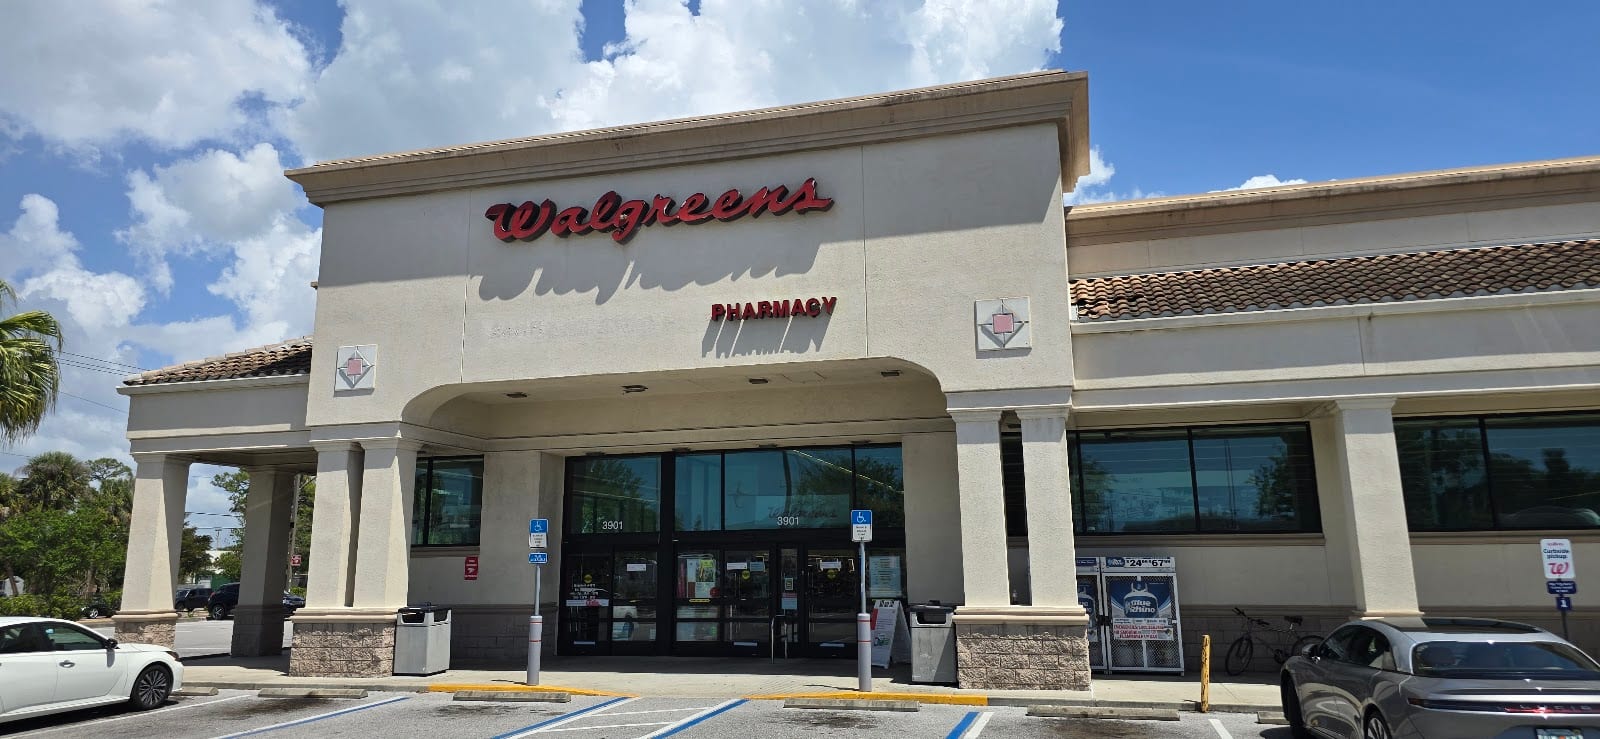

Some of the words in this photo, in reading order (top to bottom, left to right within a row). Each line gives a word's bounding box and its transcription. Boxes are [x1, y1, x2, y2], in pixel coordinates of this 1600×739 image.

[485, 177, 834, 244] Walgreens
[711, 296, 837, 321] PHARMACY
[602, 520, 624, 530] 3901
[777, 516, 799, 526] 3901
[1560, 599, 1568, 608] 1
